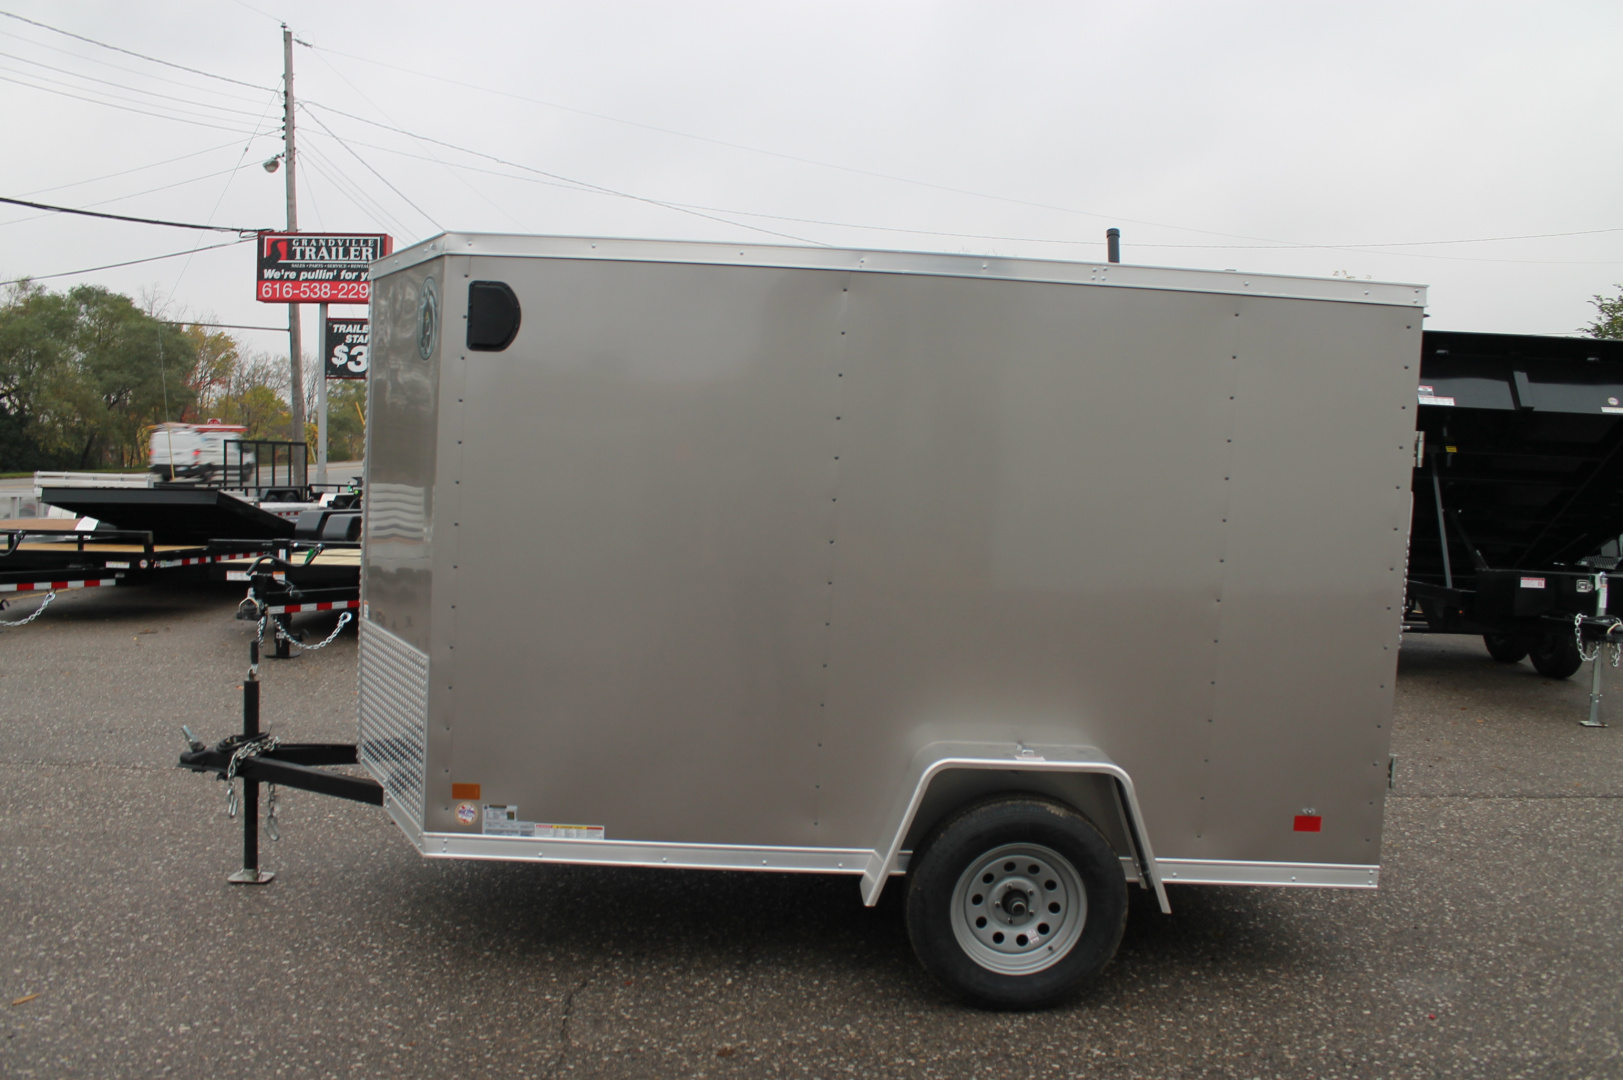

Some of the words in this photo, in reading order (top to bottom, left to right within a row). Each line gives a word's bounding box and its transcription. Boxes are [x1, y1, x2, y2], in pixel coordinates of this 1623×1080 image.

[292, 238, 374, 246] GRANDVILLE
[292, 246, 374, 260] TRAILER
[264, 268, 296, 279] We're
[300, 270, 337, 281] pullin'
[340, 270, 358, 280] for
[360, 272, 369, 281] y
[262, 282, 369, 298] 616-538-229
[333, 324, 368, 333] TRAILE
[332, 343, 368, 372] $3
